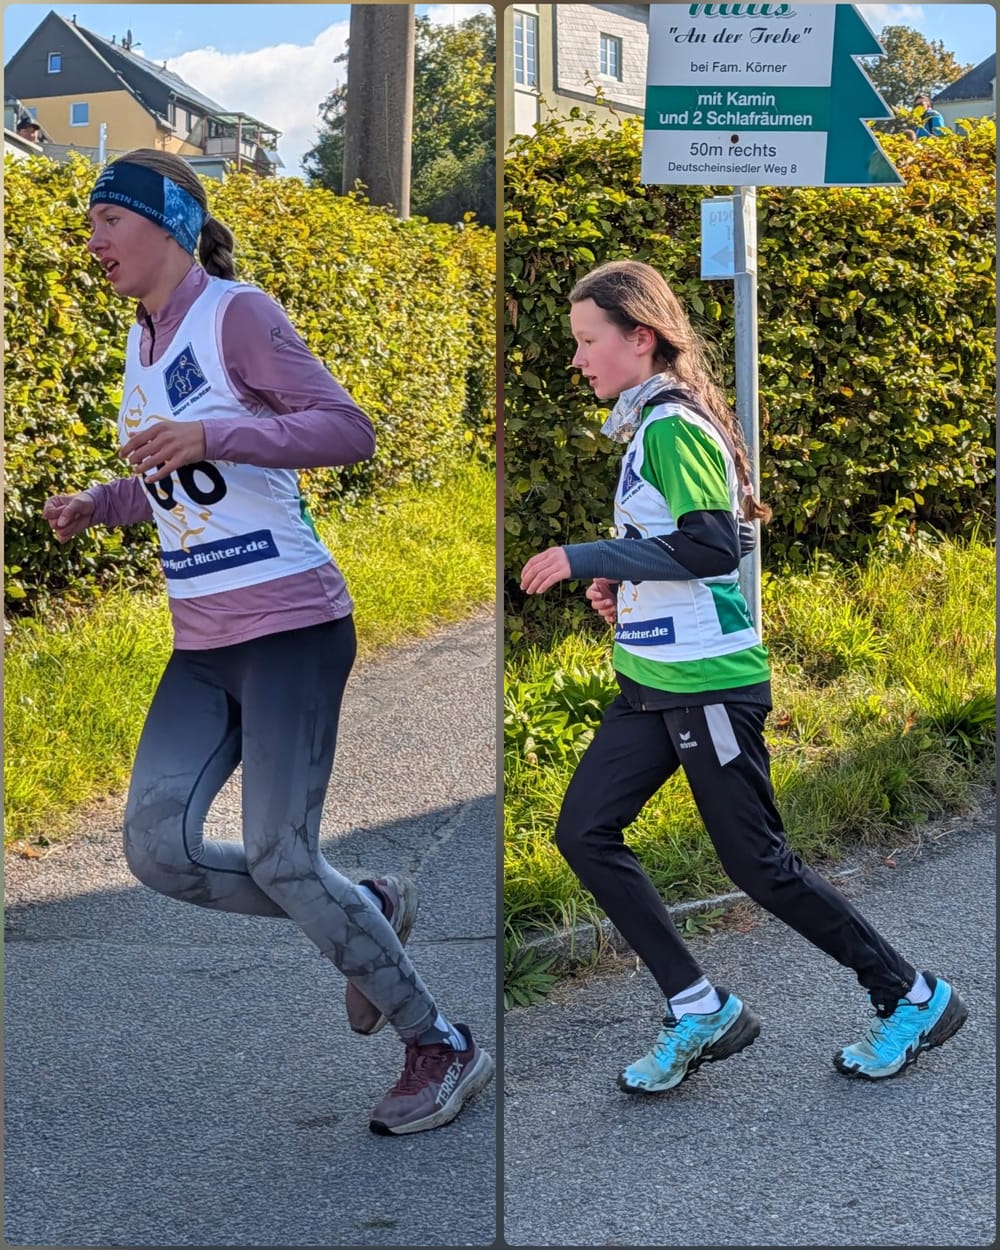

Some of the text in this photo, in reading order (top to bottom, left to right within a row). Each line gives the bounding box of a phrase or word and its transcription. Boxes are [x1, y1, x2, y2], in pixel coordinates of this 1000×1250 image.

[669, 27, 812, 44] "An der Trebe"
[690, 61, 787, 73] bei Fam. Körner
[698, 91, 776, 106] mit Kamin
[659, 111, 812, 126] und 2 Schlafräumen
[689, 142, 777, 157] 50m rechts
[668, 161, 797, 175] Deutscheinsiedler Weg 8
[108, 191, 132, 204] DEIN
[194, 539, 270, 566] Richter.de
[435, 1056, 464, 1107] TERREX
